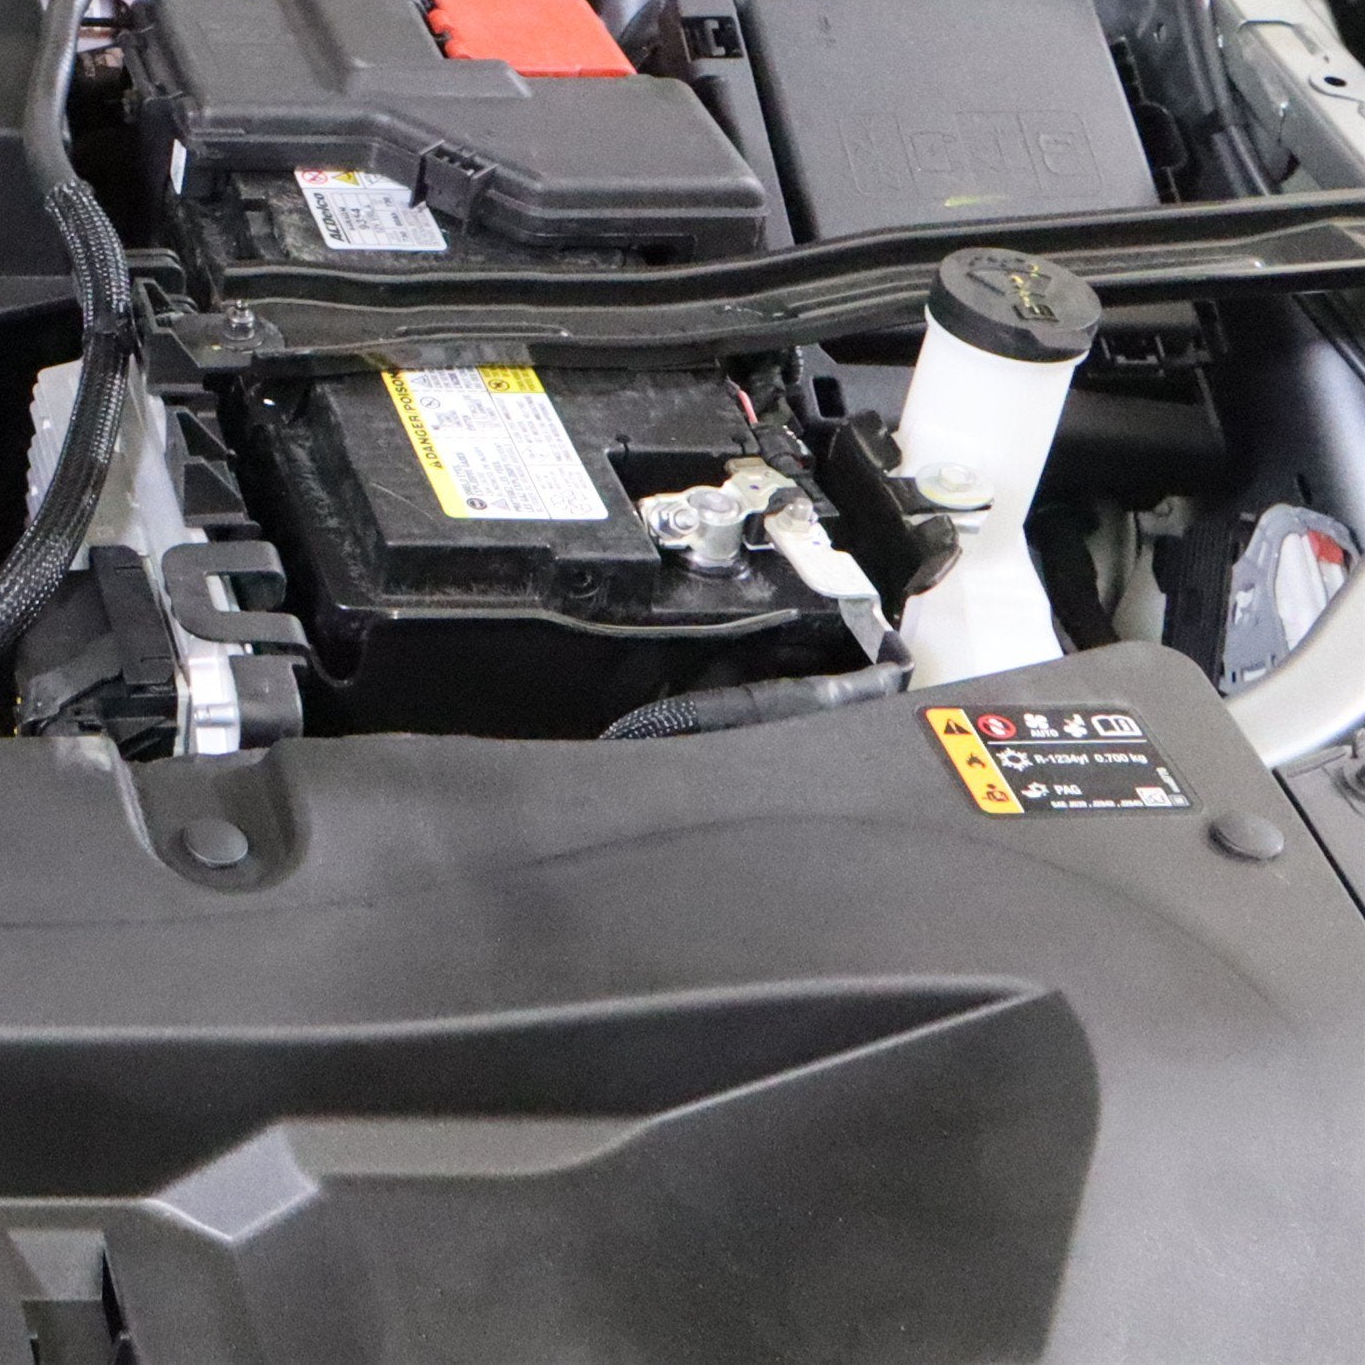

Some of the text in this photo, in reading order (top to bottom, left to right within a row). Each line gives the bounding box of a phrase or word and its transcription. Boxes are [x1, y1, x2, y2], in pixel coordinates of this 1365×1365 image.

[314, 192, 344, 242] ACDelco
[1030, 729, 1059, 737] AUTO
[1033, 753, 1148, 765] R-1234yf 0.700 kg
[1053, 784, 1083, 795] PAG
